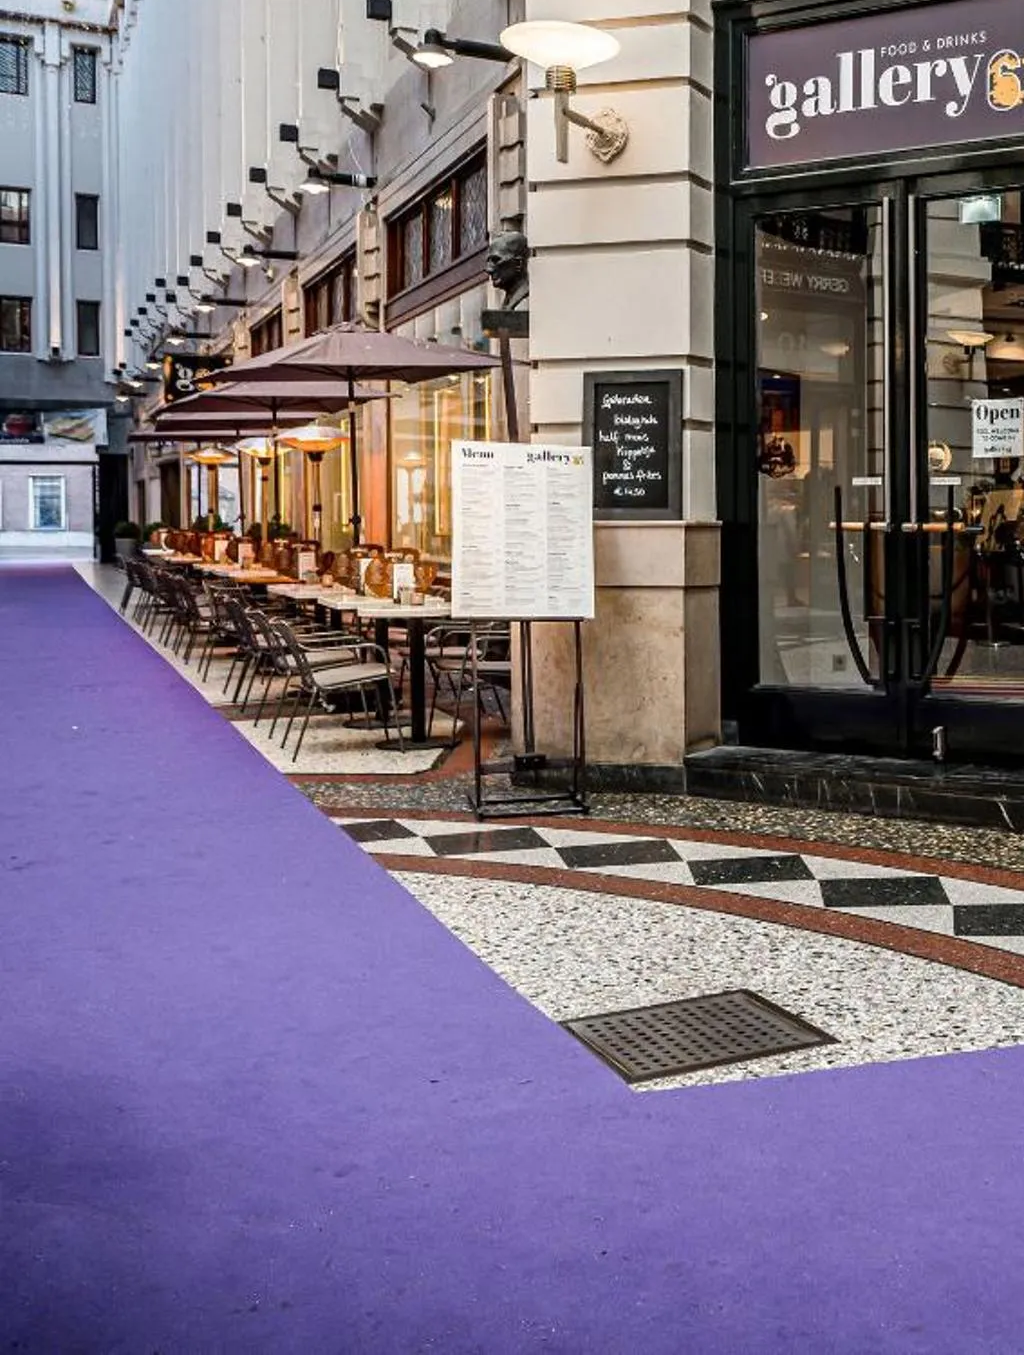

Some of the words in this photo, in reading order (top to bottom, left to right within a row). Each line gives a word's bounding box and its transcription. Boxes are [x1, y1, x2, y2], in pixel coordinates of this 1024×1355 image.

[880, 41, 917, 58] FOOD
[922, 40, 931, 52] &
[936, 30, 987, 50] DRINKS
[976, 405, 1020, 424] Open
[462, 448, 494, 458] Menu
